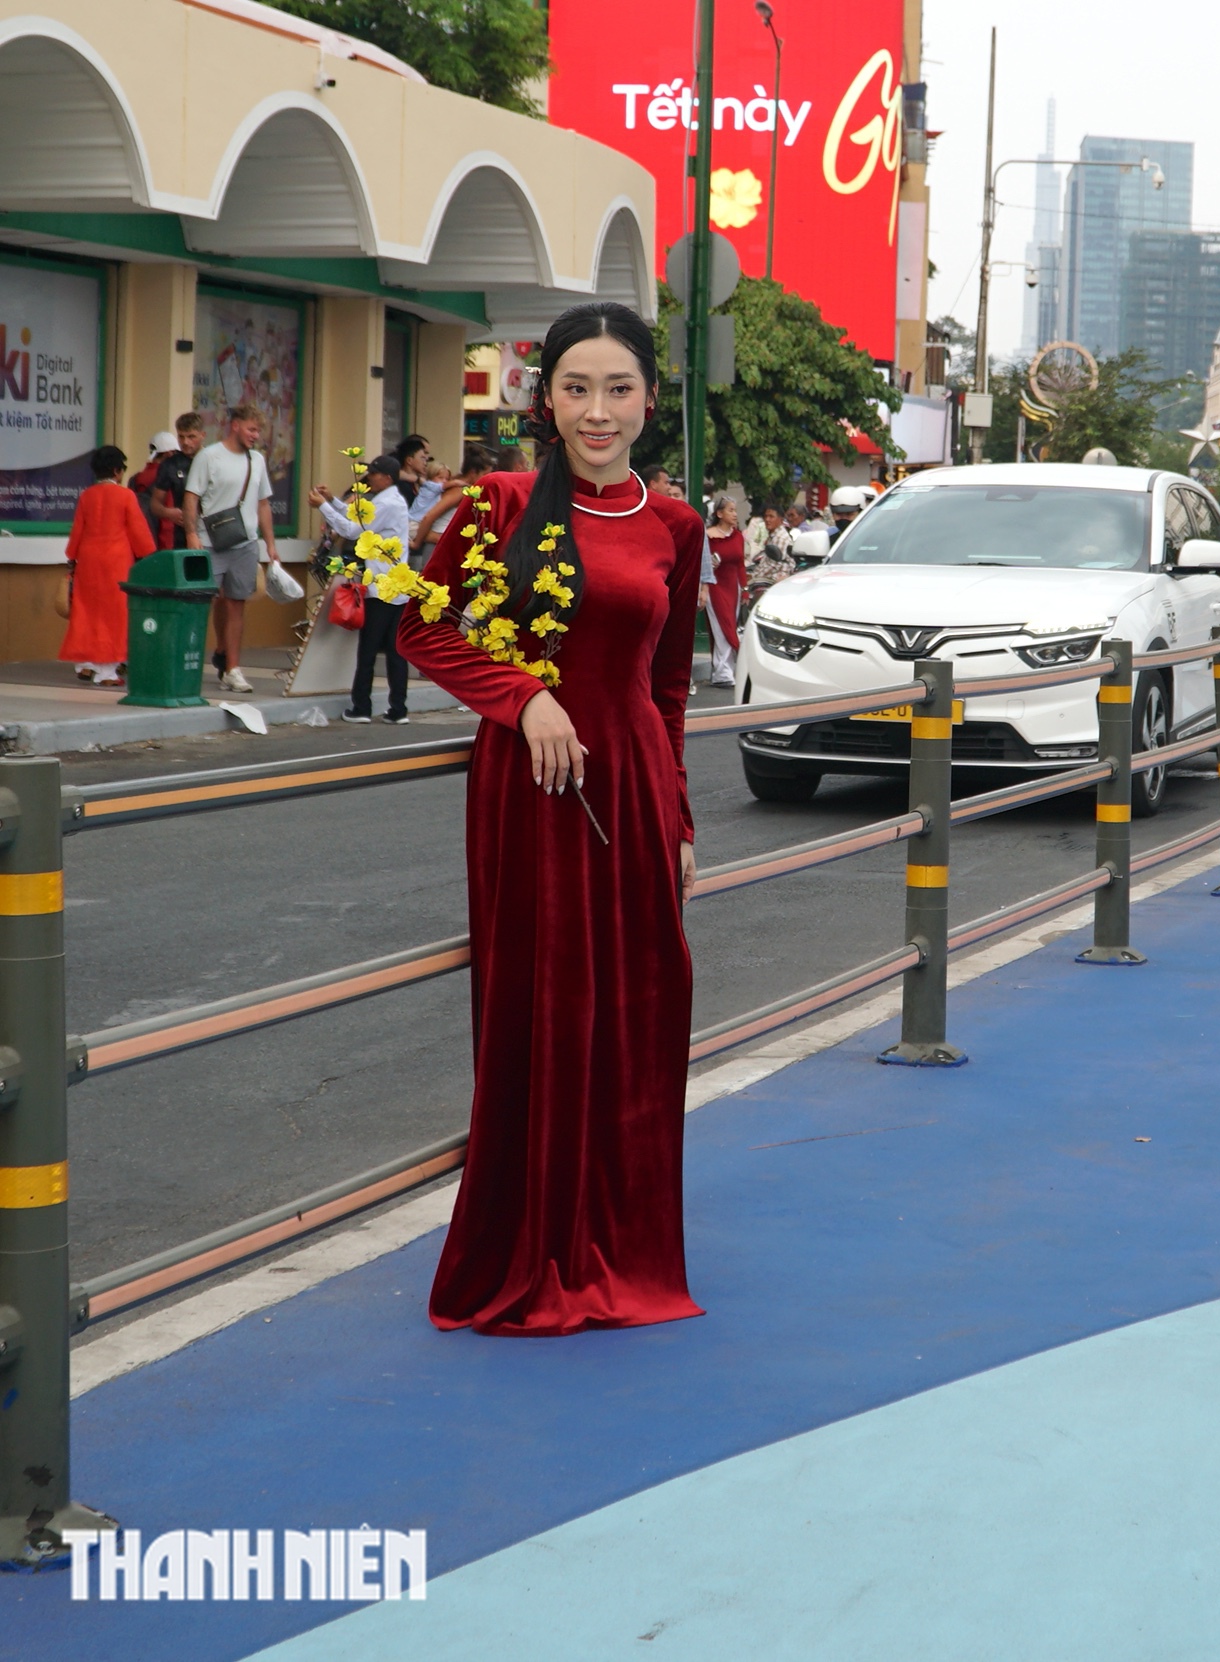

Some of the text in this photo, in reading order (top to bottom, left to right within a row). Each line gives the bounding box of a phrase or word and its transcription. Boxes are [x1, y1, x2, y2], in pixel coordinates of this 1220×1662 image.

[612, 78, 699, 130] Tết
[713, 84, 812, 146] này
[36, 353, 73, 375] Digital
[36, 375, 83, 406] Bank
[6, 410, 32, 432] kiệm
[35, 411, 52, 430] Tốt
[55, 413, 82, 432] nhất!
